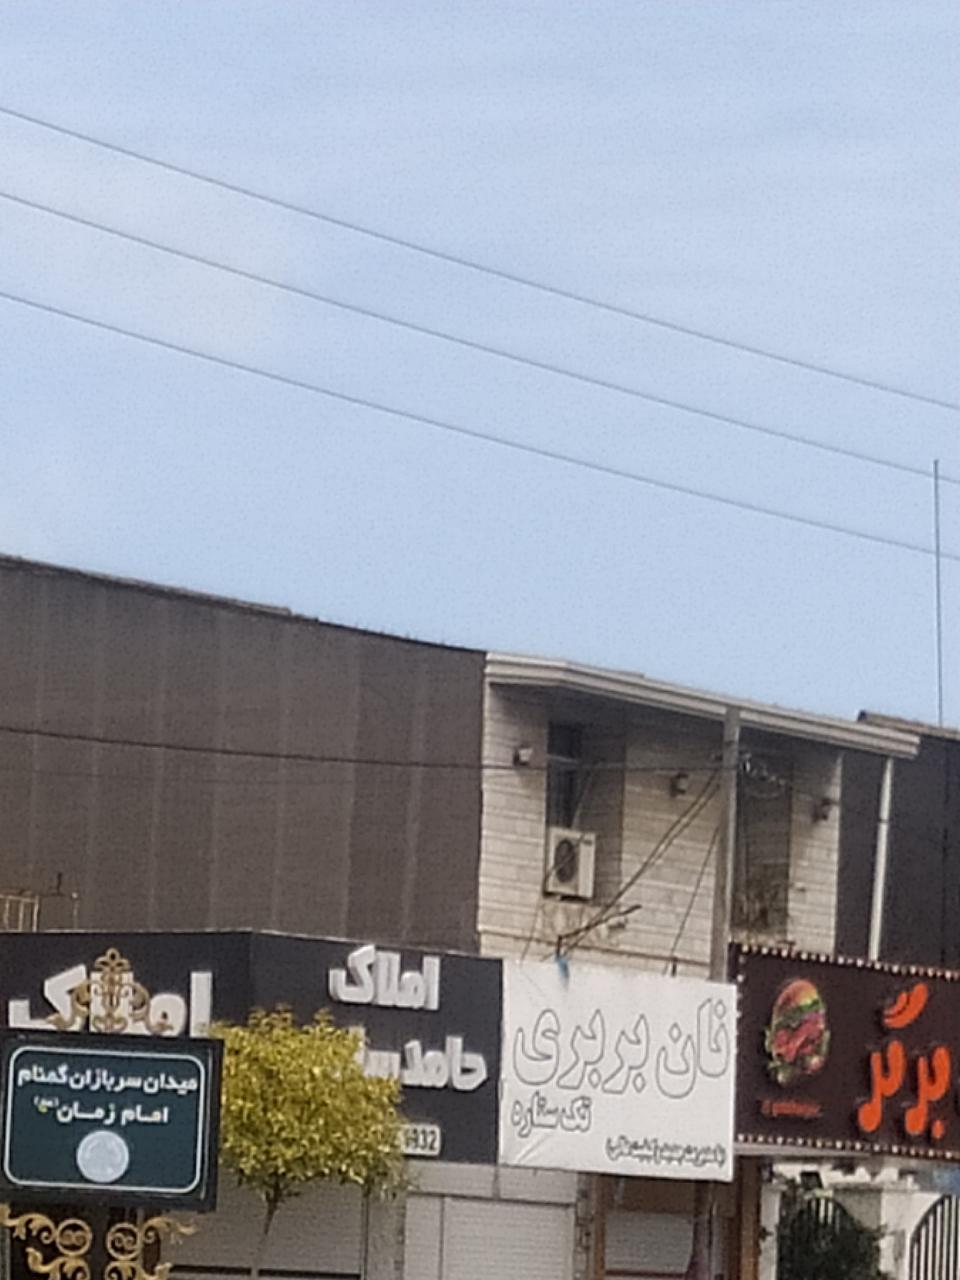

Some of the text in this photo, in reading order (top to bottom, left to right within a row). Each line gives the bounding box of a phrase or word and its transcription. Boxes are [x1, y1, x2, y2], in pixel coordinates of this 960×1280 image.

[329, 945, 440, 1010] املاک
[17, 1064, 198, 1095] میدان سربازان گمنام
[513, 1008, 650, 1095] بربری
[656, 998, 730, 1099] نان
[857, 983, 951, 1139] برگر
[56, 1101, 116, 1125] زمان
[121, 1104, 169, 1126] امام
